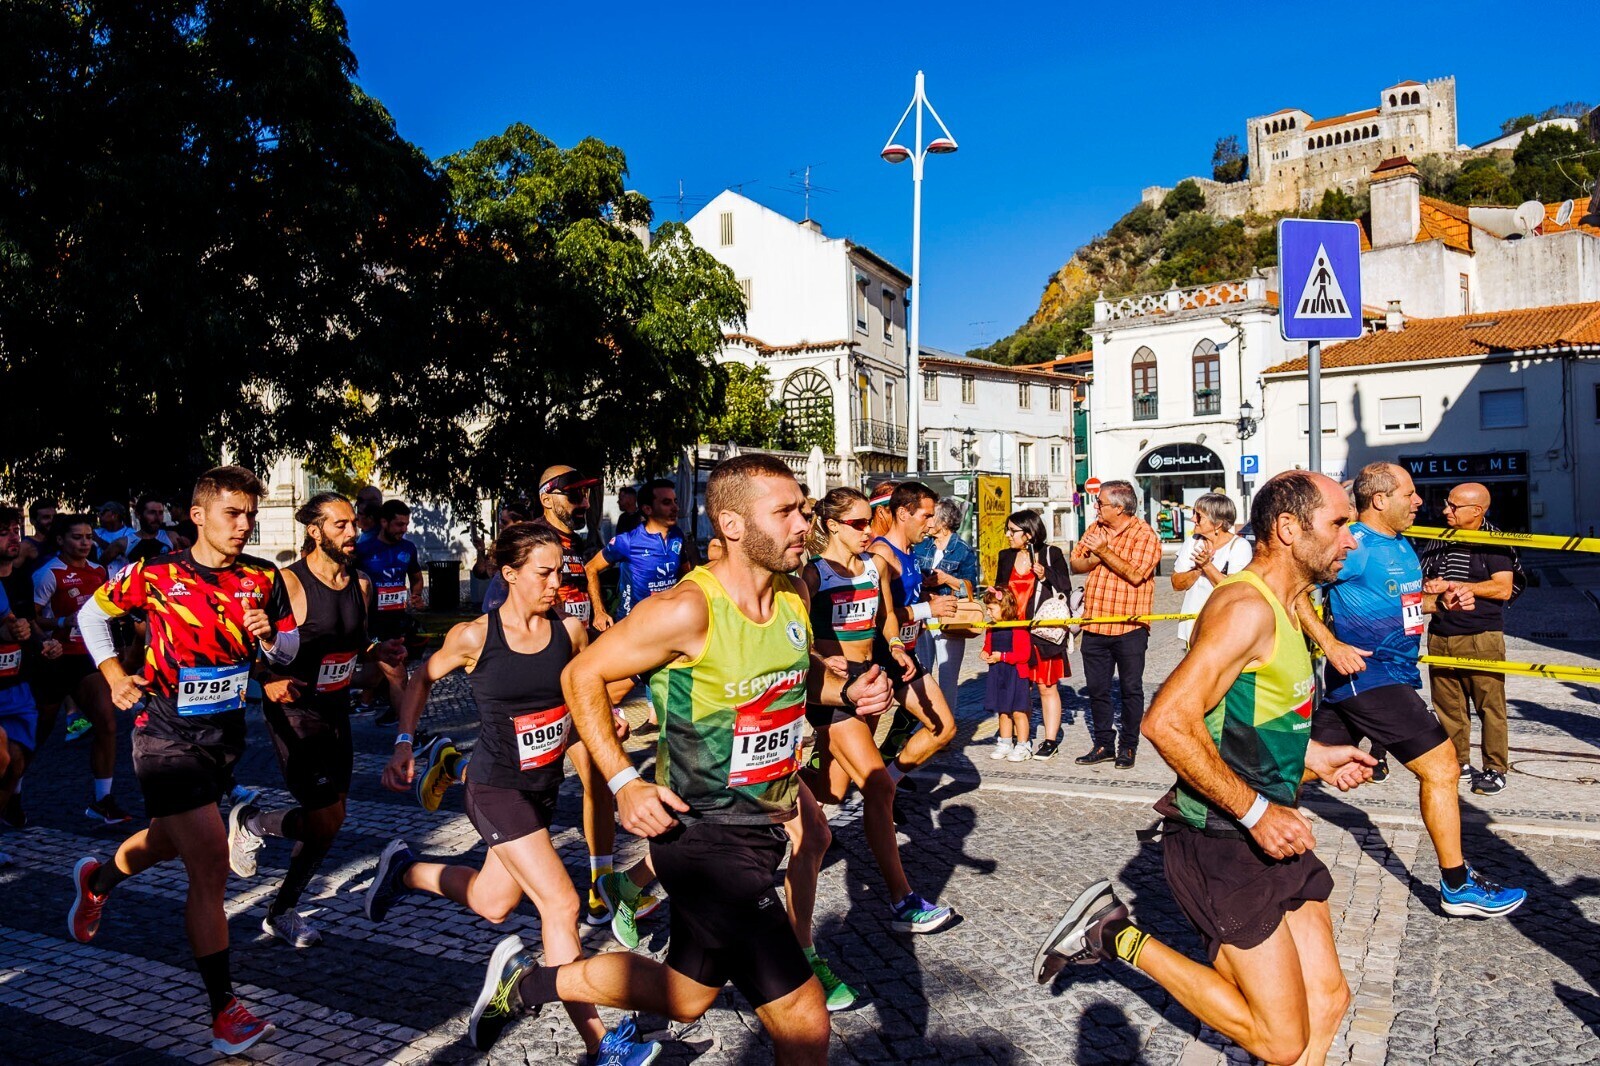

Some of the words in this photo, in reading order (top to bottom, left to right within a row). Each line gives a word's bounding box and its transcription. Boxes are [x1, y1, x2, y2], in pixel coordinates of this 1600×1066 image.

[1163, 454, 1211, 465] SKULK
[1244, 456, 1255, 472] P
[837, 602, 866, 615] 1171
[184, 679, 231, 694] 0792
[522, 722, 564, 746] 0908
[741, 728, 789, 754] 1265
